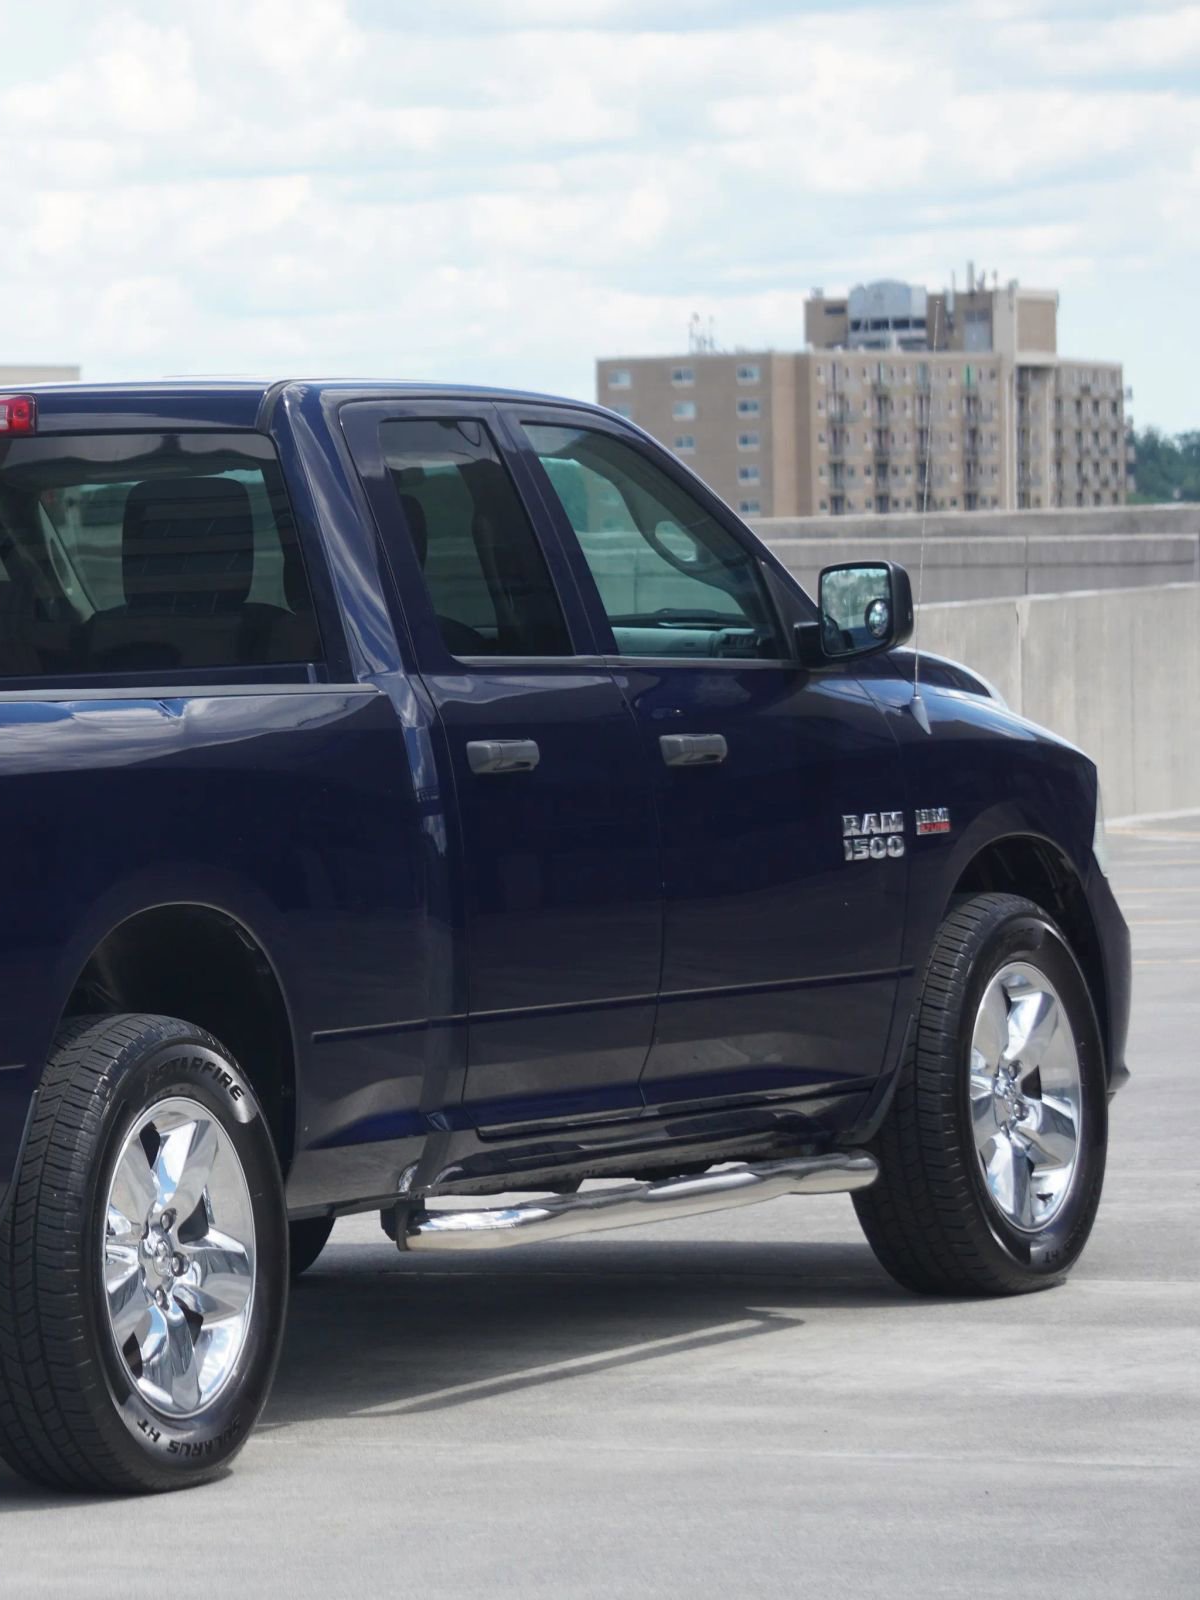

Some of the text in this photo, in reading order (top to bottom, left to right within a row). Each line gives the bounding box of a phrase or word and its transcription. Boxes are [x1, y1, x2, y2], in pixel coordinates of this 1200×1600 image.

[842, 811, 904, 837] RAM
[843, 836, 905, 861] 1500
[158, 1056, 246, 1101] STARFIRE
[136, 1418, 161, 1443] HT
